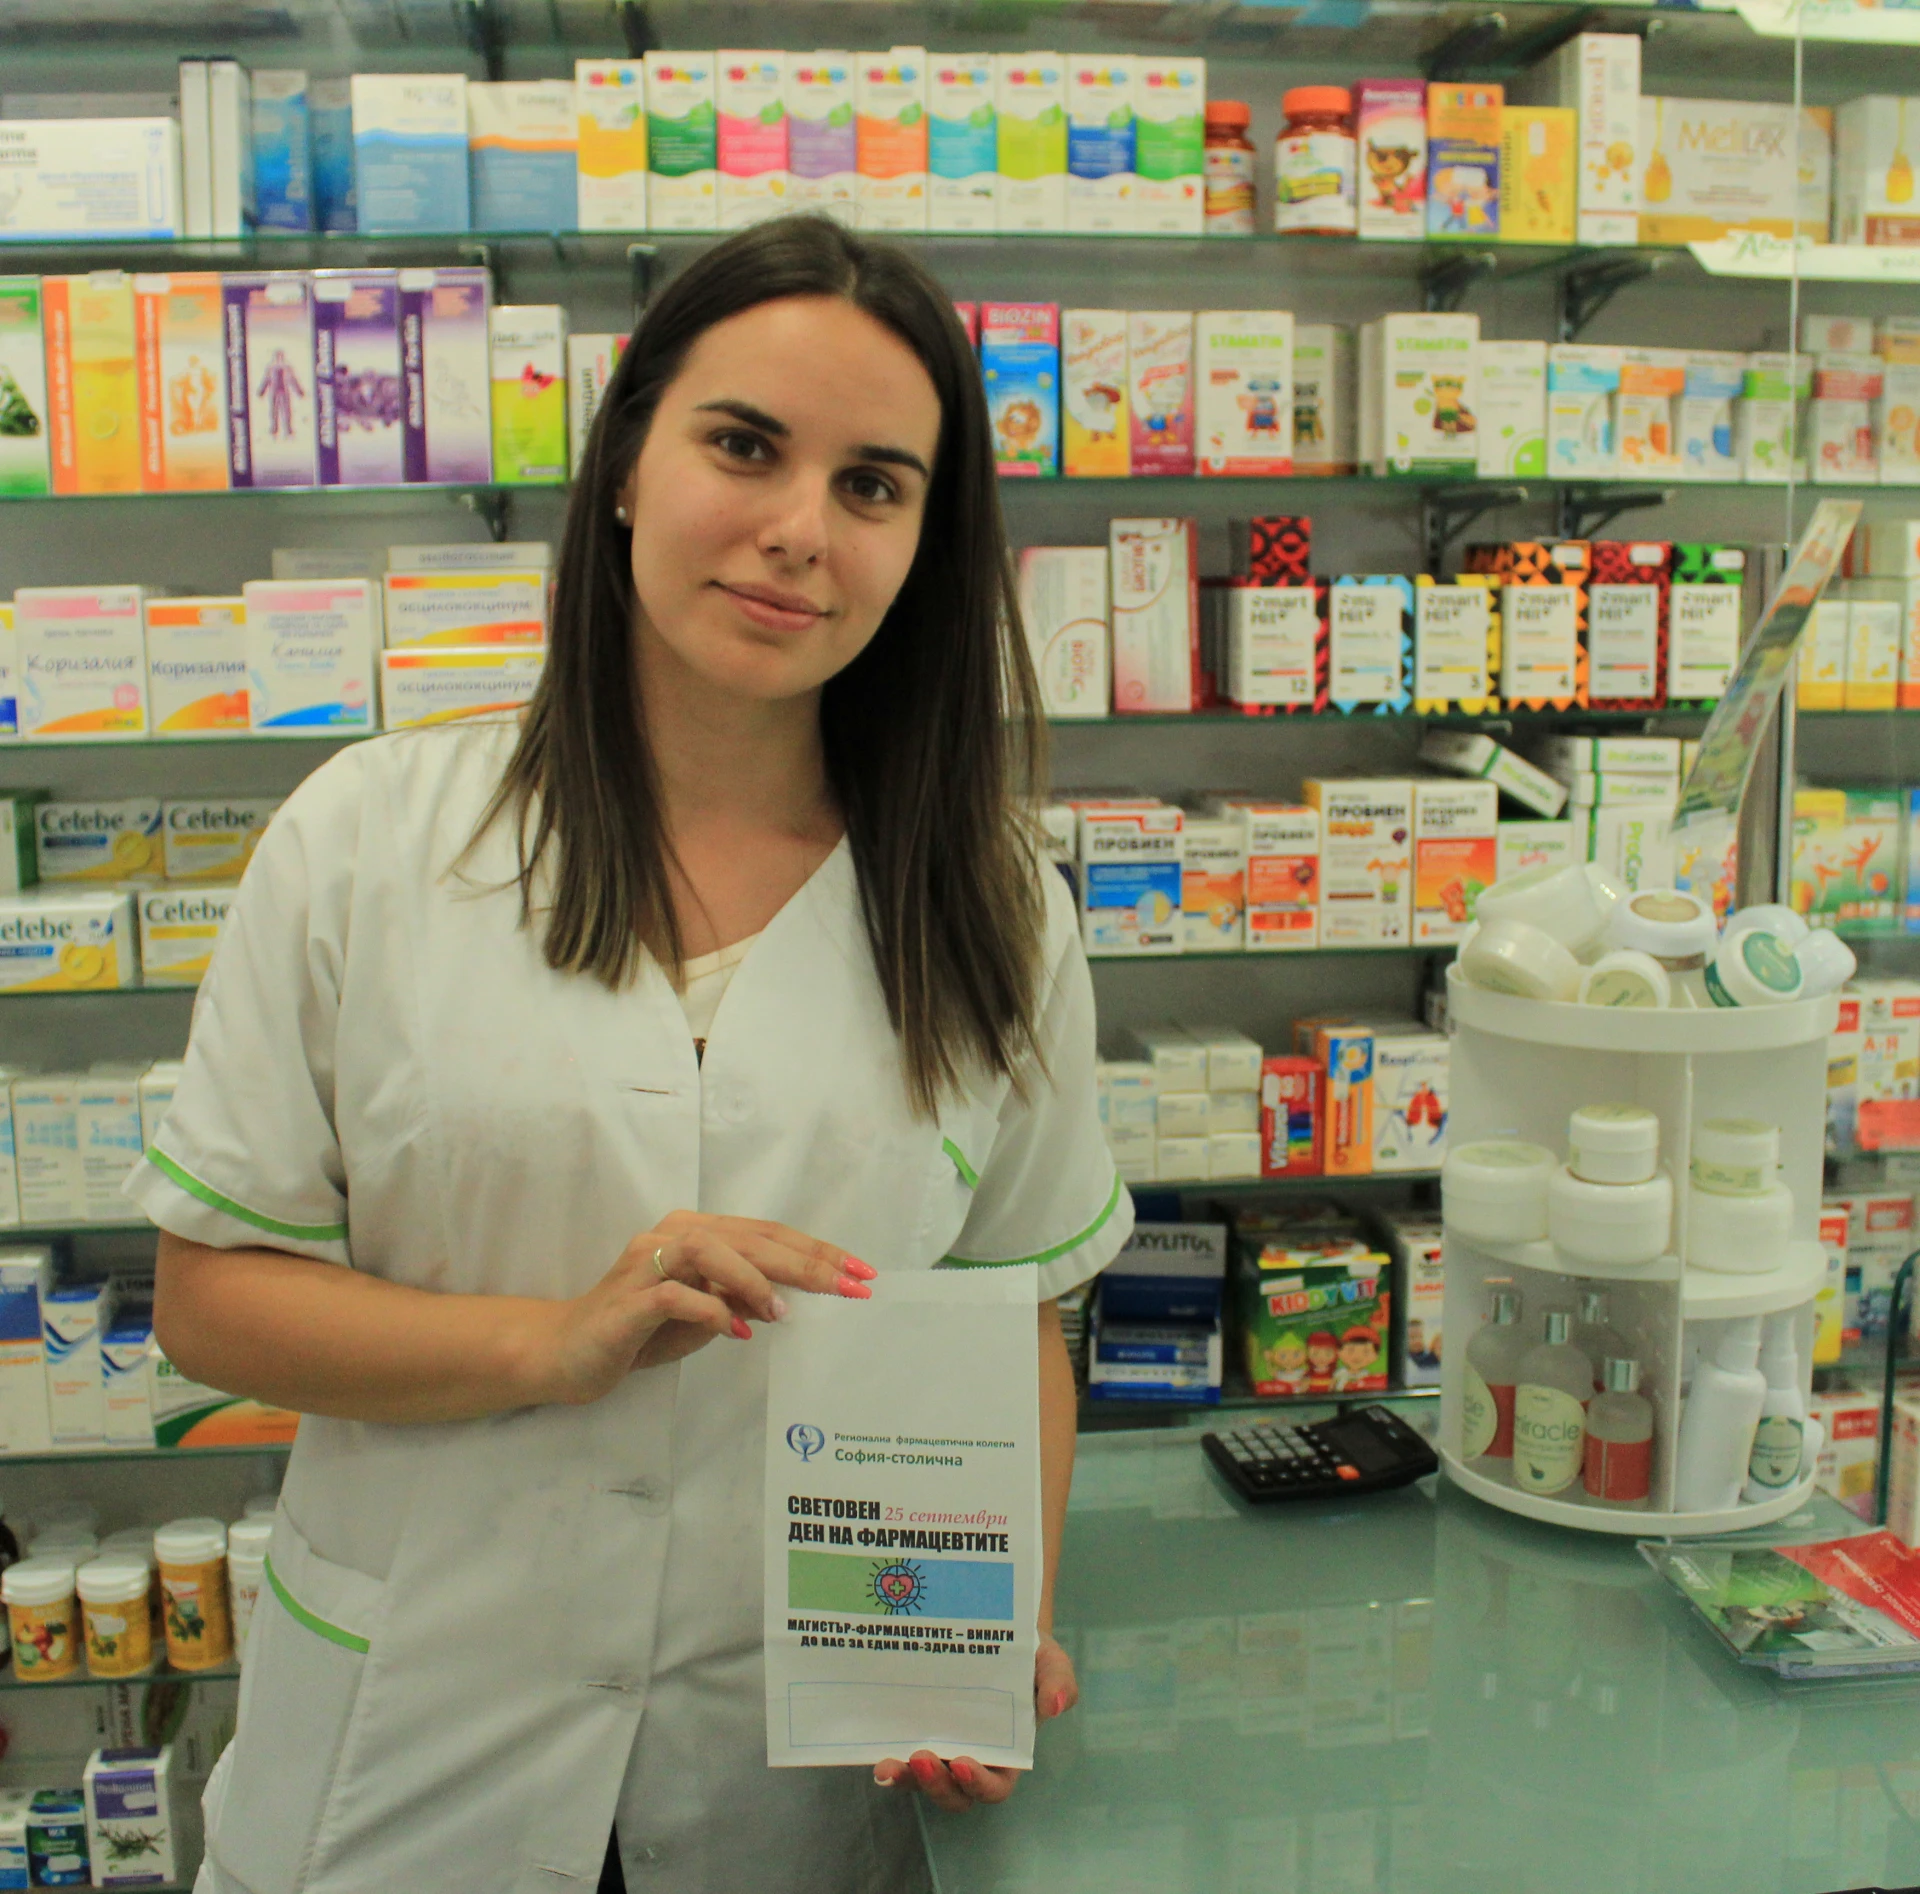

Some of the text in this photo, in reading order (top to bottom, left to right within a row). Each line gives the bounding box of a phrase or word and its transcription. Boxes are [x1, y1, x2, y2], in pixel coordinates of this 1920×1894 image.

[988, 309, 1052, 325] BIOZIN
[26, 653, 136, 678] Коризалия
[151, 659, 247, 678] Коризалия
[40, 808, 124, 831] Cetebe
[168, 807, 255, 829] Cetebe
[1328, 804, 1405, 818] ПРОБИЕН
[1093, 837, 1175, 852] ПРОБИЕН
[0, 917, 73, 940] etebe
[834, 1432, 1015, 1449] Регионална фармацевтична колегия
[834, 1448, 963, 1467] София-столична
[787, 1495, 1008, 1529] СВЕТОВЕН 25 септември
[788, 1521, 1009, 1553] ДЕН НА ФАРМАЦЕВТИТЕ
[787, 1618, 953, 1639] МАГИСТЪР-ФАРМАЦЕВТИТЕ
[967, 1628, 1014, 1642] ВИНАГИ
[801, 1635, 1001, 1655] ДО ВАС ЗА ЕДИН ПО-ЗДРАВ СВЯТ
